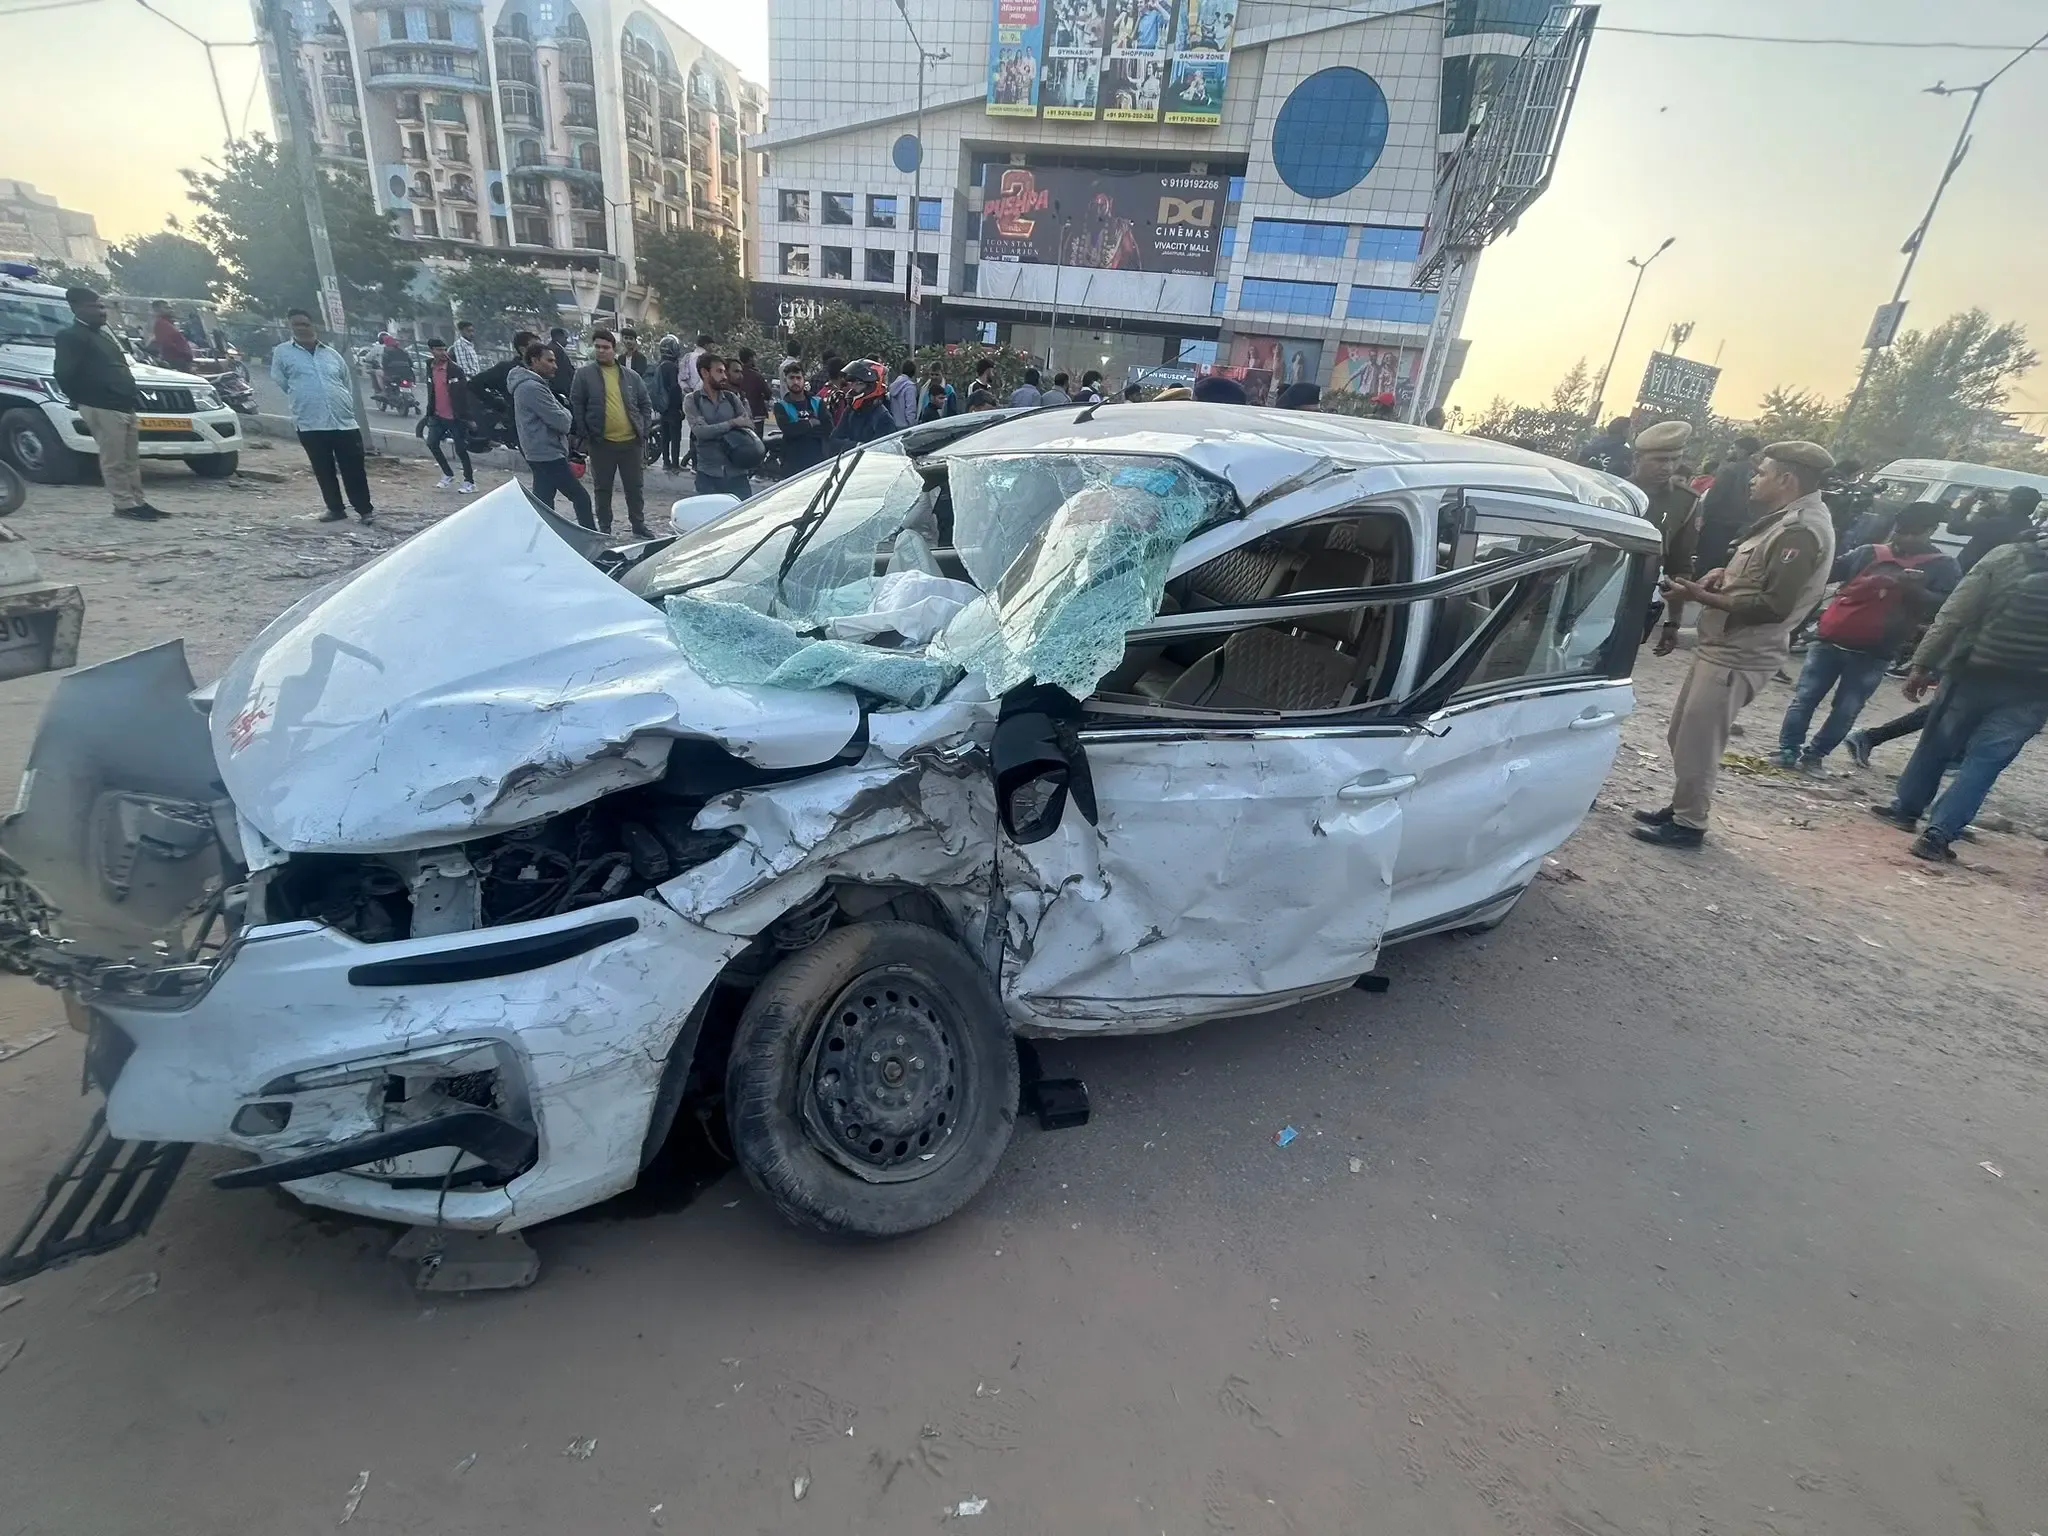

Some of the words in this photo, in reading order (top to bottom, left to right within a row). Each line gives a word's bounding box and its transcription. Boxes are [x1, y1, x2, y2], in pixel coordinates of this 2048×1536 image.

[1169, 178, 1219, 190] 9119192266
[1155, 227, 1210, 239] CINEMAS
[1011, 240, 1033, 248] STAR
[1154, 241, 1188, 250] VIVACITY
[1189, 243, 1211, 253] MALL
[1010, 248, 1040, 256] ARJUN
